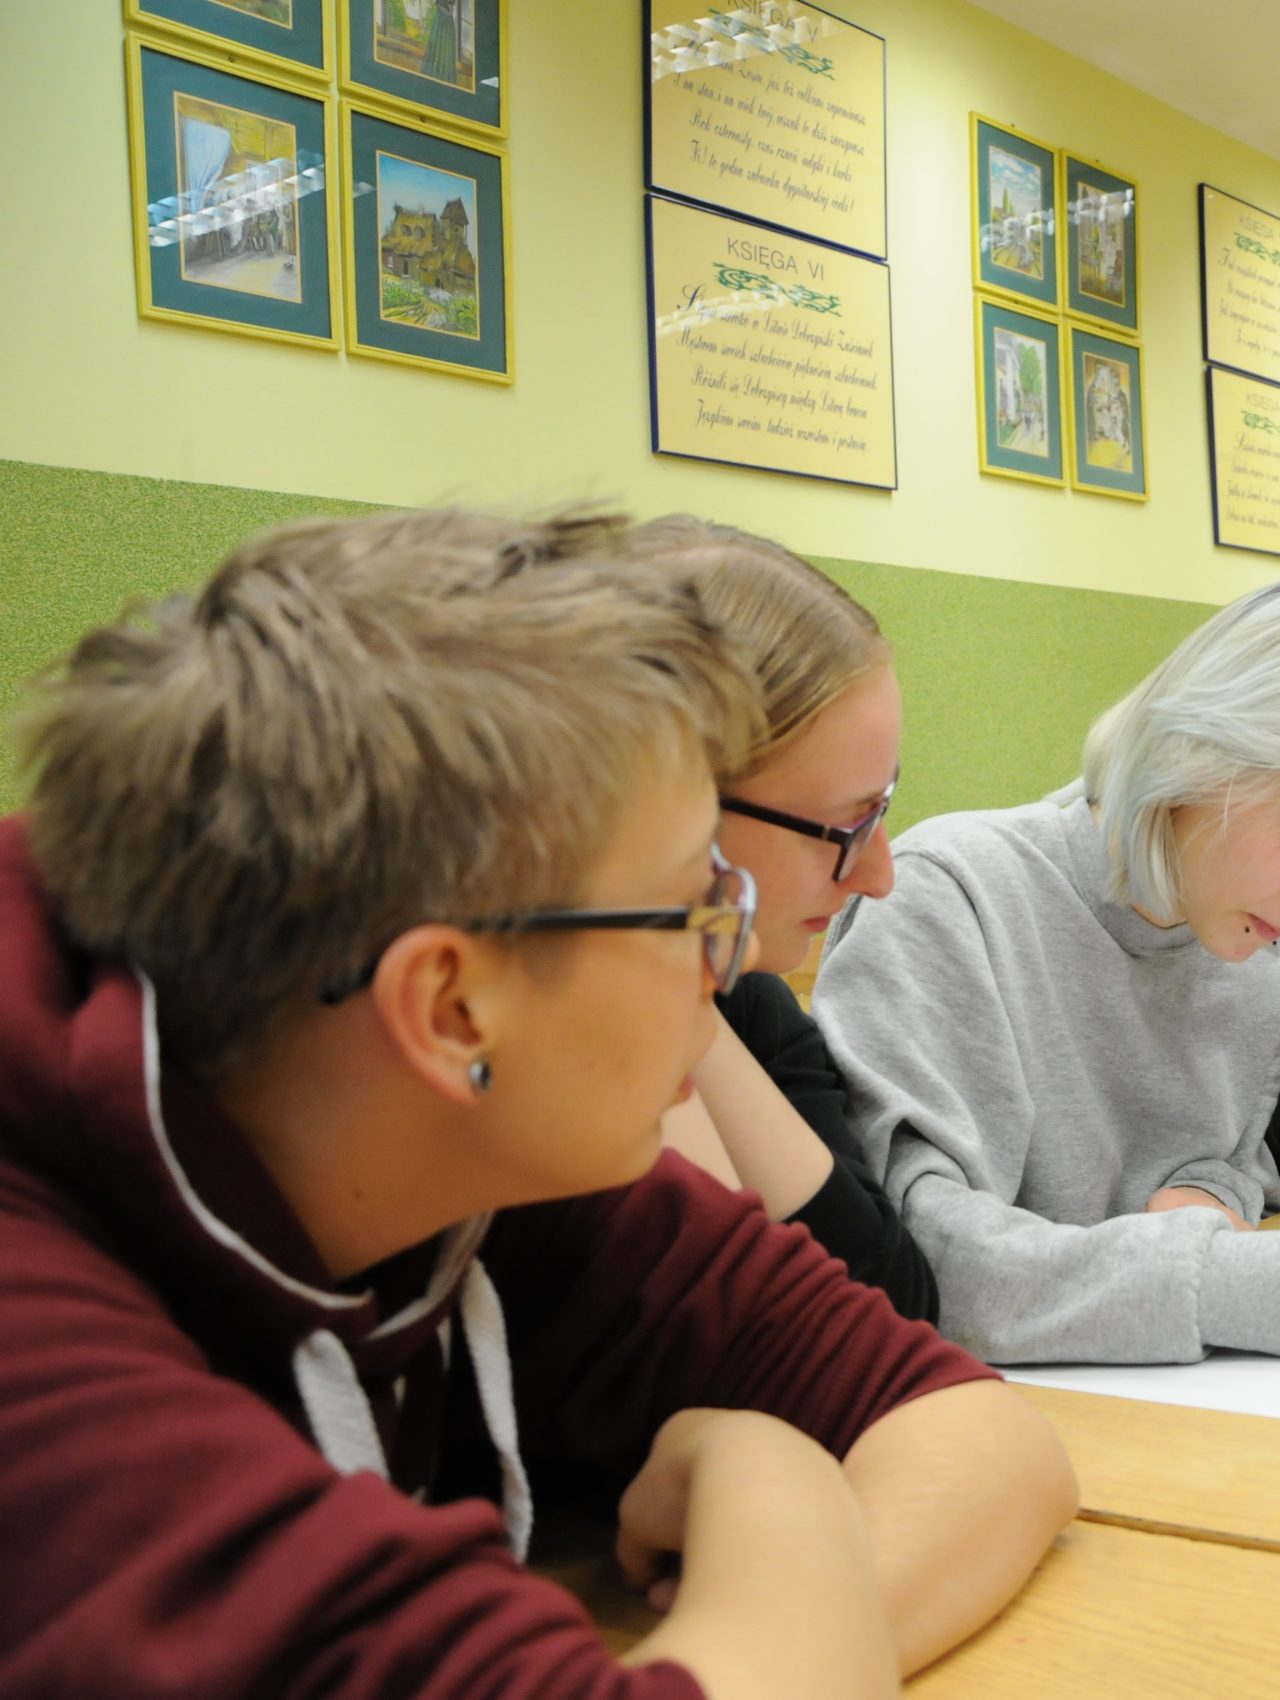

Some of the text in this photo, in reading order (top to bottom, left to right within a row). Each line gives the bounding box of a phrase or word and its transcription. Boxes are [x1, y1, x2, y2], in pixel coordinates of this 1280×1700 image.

[807, 24, 818, 42] V
[727, 236, 825, 281] KSIĘGA VI
